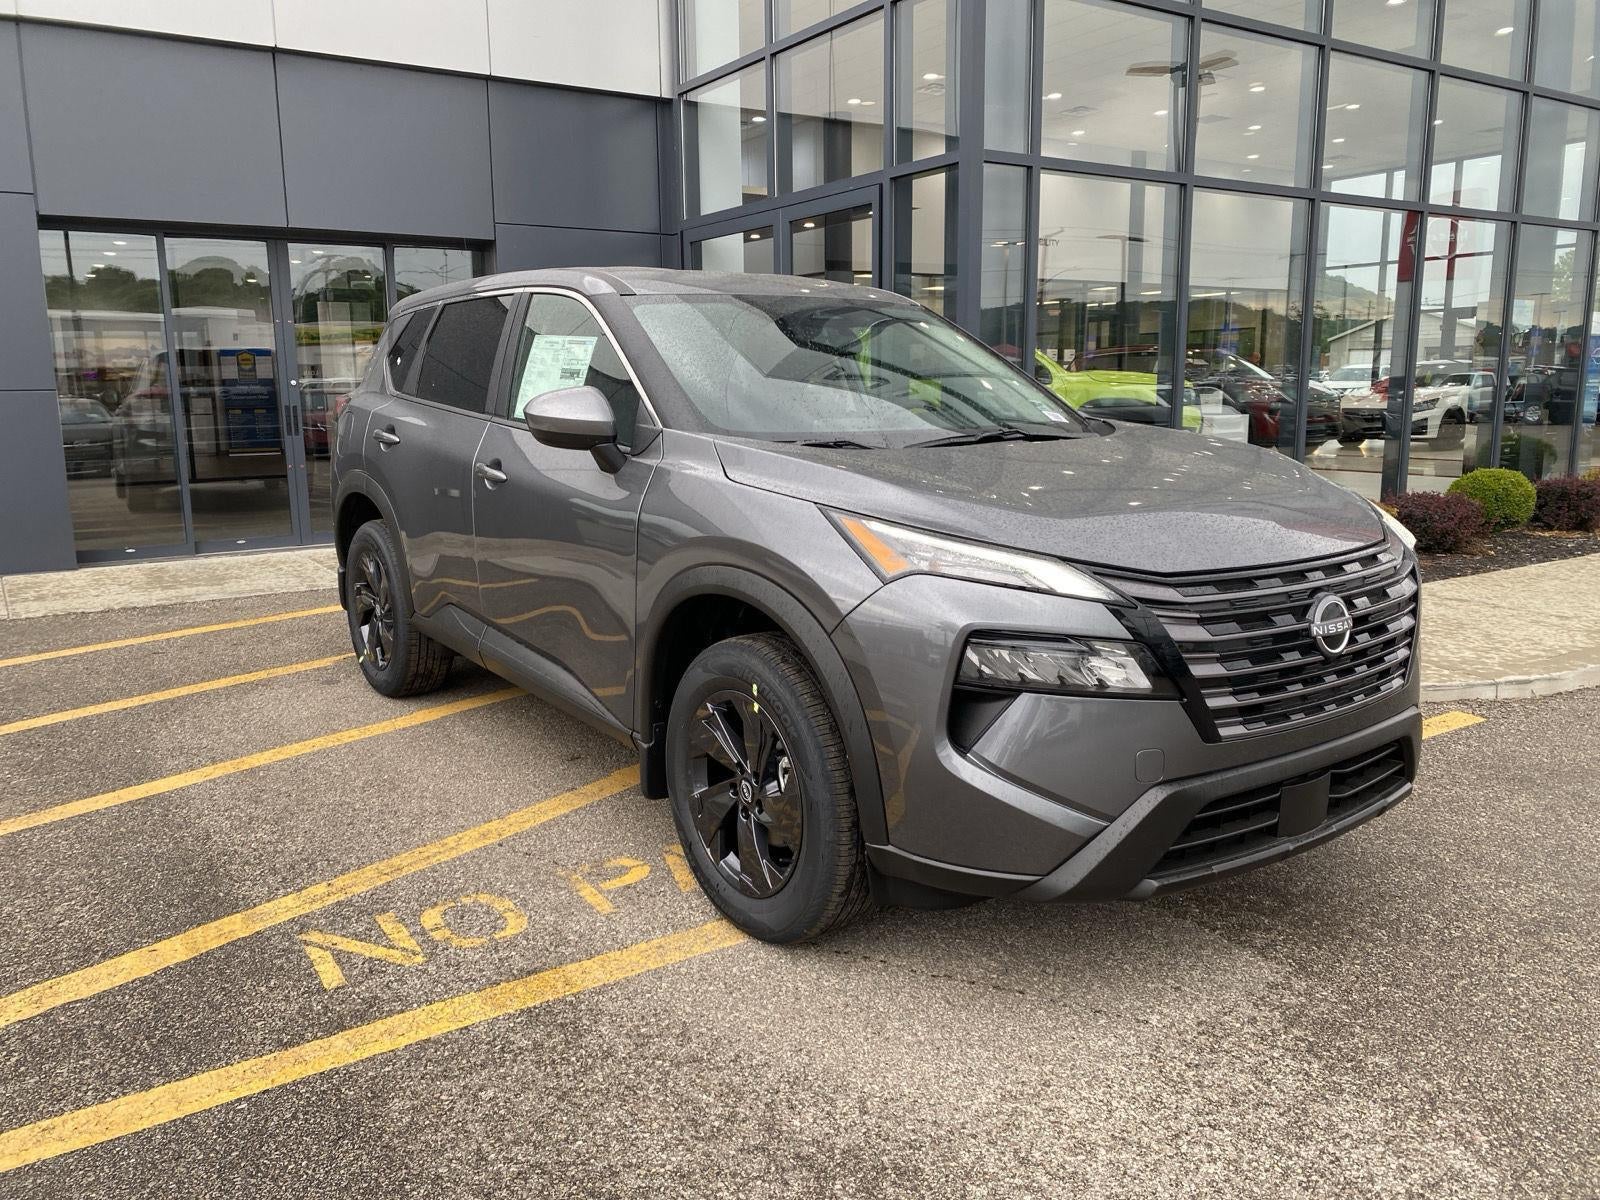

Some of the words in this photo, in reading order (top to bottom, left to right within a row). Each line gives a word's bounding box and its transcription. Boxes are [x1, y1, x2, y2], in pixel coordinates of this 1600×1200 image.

[1313, 618, 1353, 635] NISSAN
[299, 892, 529, 991] NO
[557, 843, 698, 915] P
